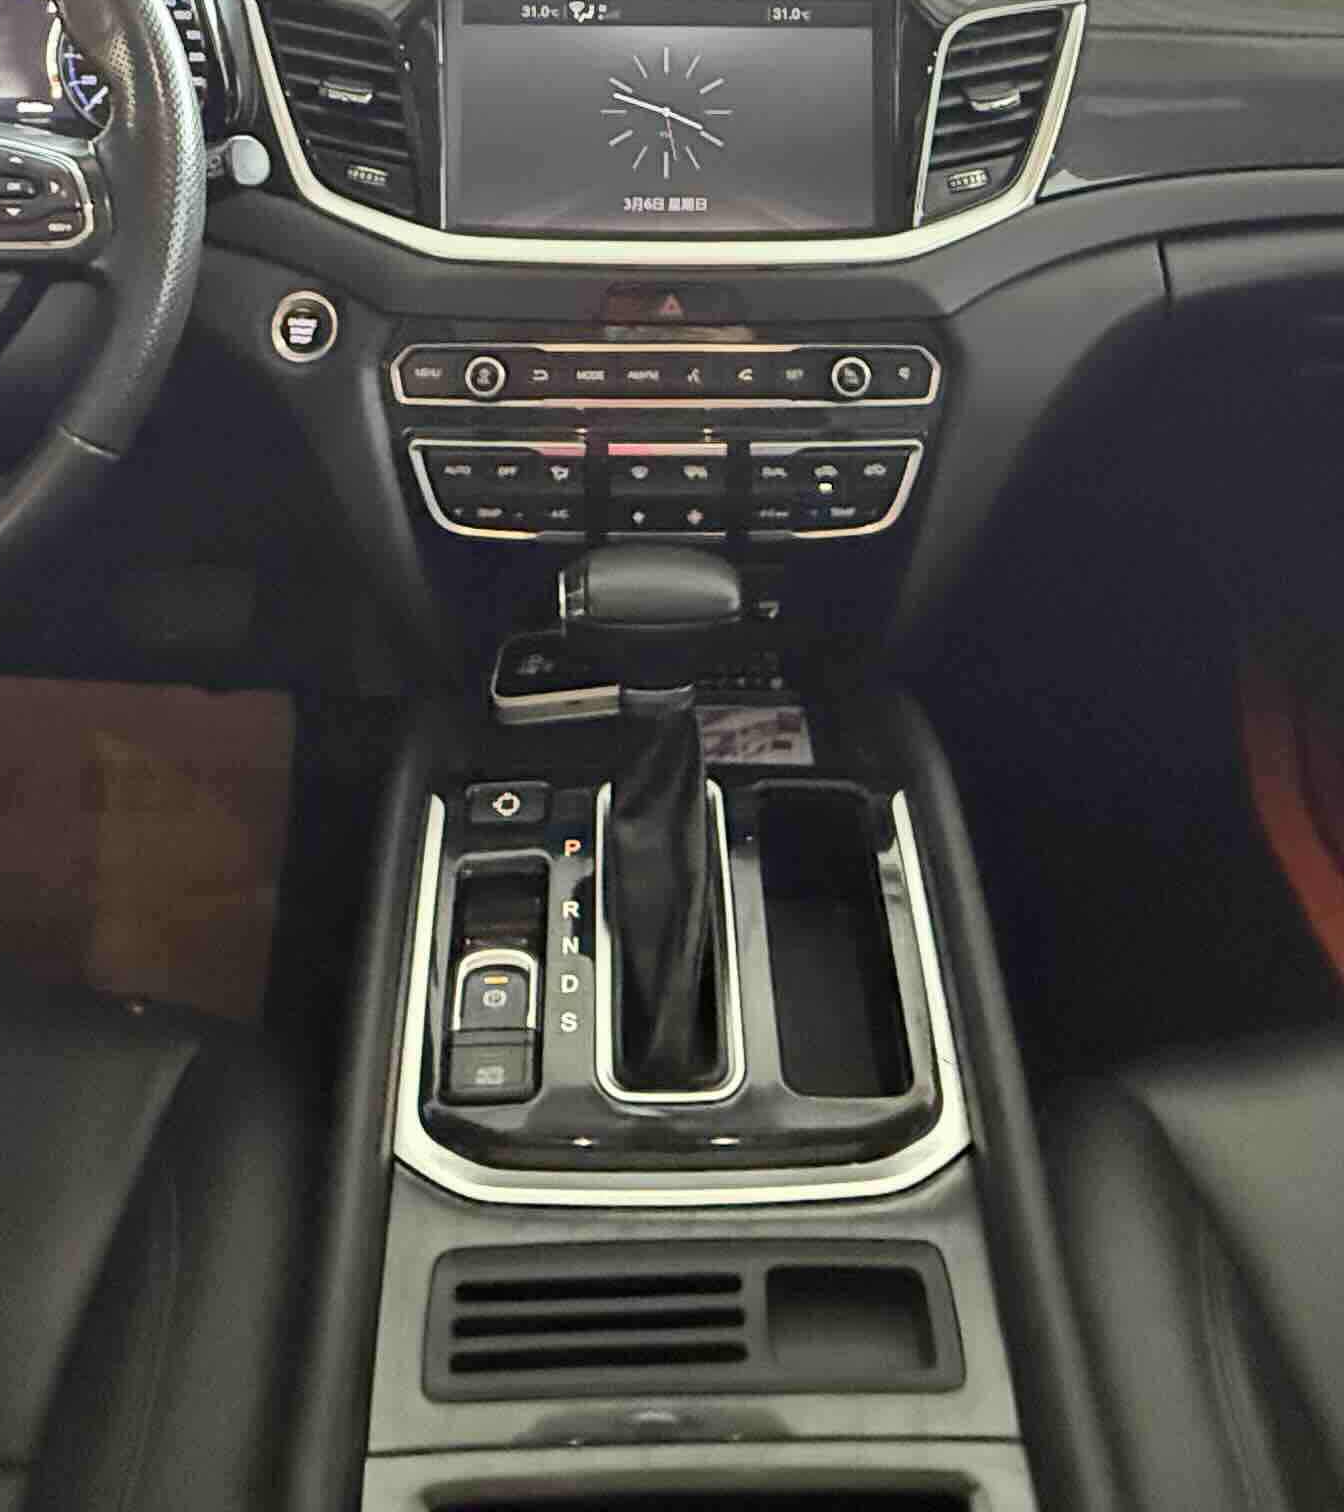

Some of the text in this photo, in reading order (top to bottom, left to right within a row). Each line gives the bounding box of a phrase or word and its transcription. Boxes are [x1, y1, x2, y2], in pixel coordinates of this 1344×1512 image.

[564, 839, 582, 857] P
[563, 901, 581, 919] R
[562, 937, 580, 955] N
[560, 974, 580, 994] D
[560, 1011, 579, 1033] S
